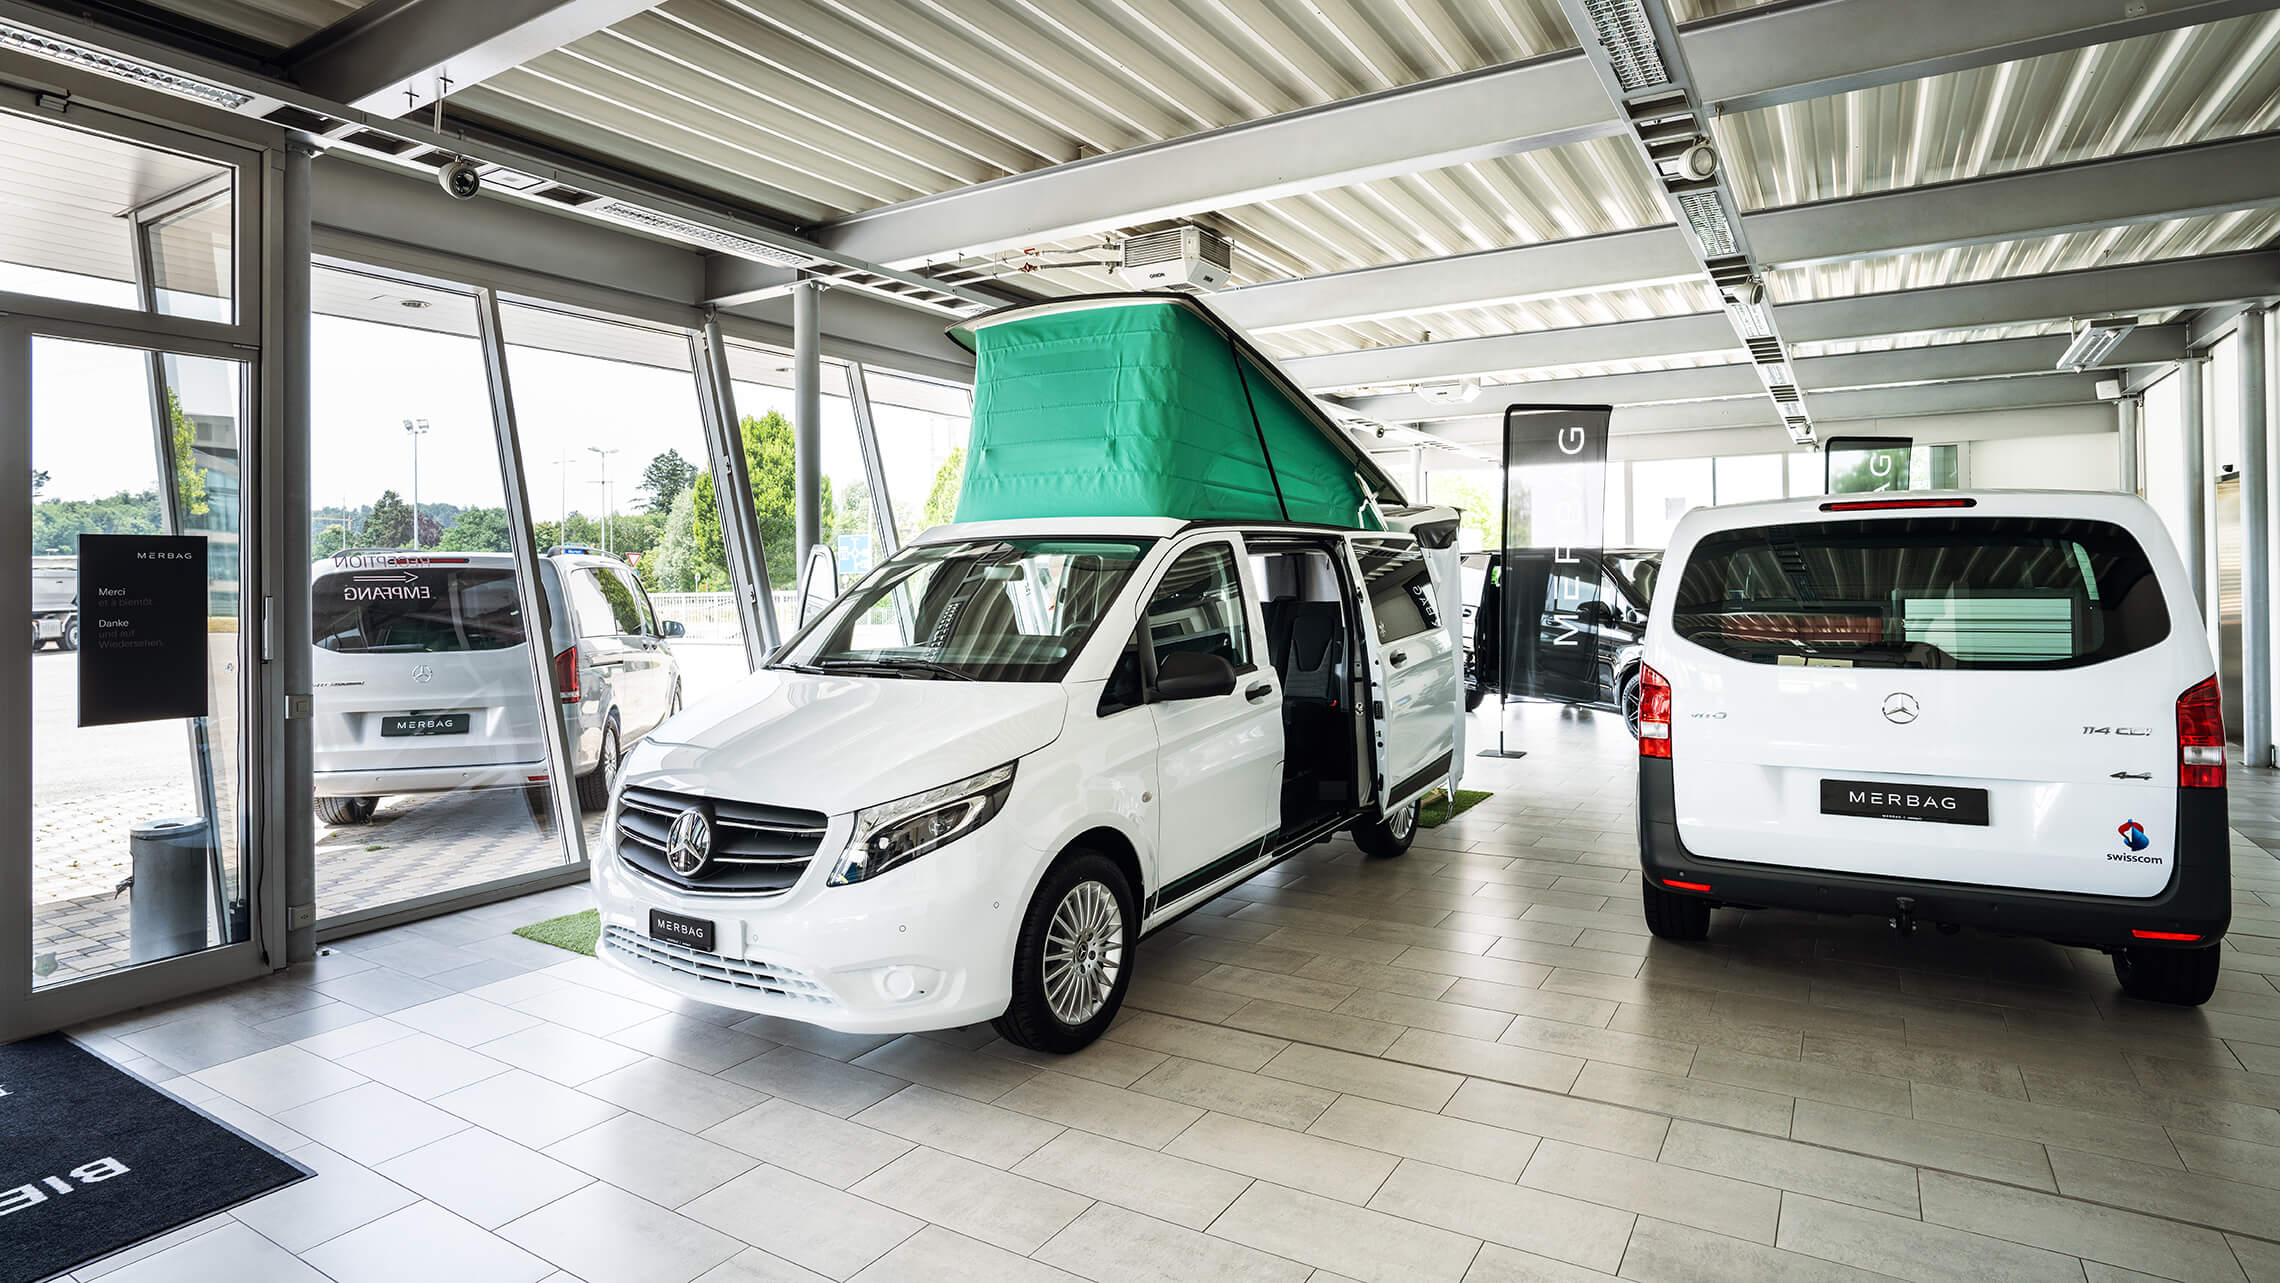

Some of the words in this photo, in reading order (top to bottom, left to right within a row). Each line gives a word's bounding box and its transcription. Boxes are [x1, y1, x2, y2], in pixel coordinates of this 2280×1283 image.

[136, 552, 193, 560] MERBAG
[98, 587, 126, 596] Merci
[98, 619, 129, 628] Danke
[397, 719, 453, 729] MERBAG
[1849, 791, 1957, 810] MERBAG
[2106, 852, 2163, 865] swisscom
[657, 918, 704, 938] MERBAG
